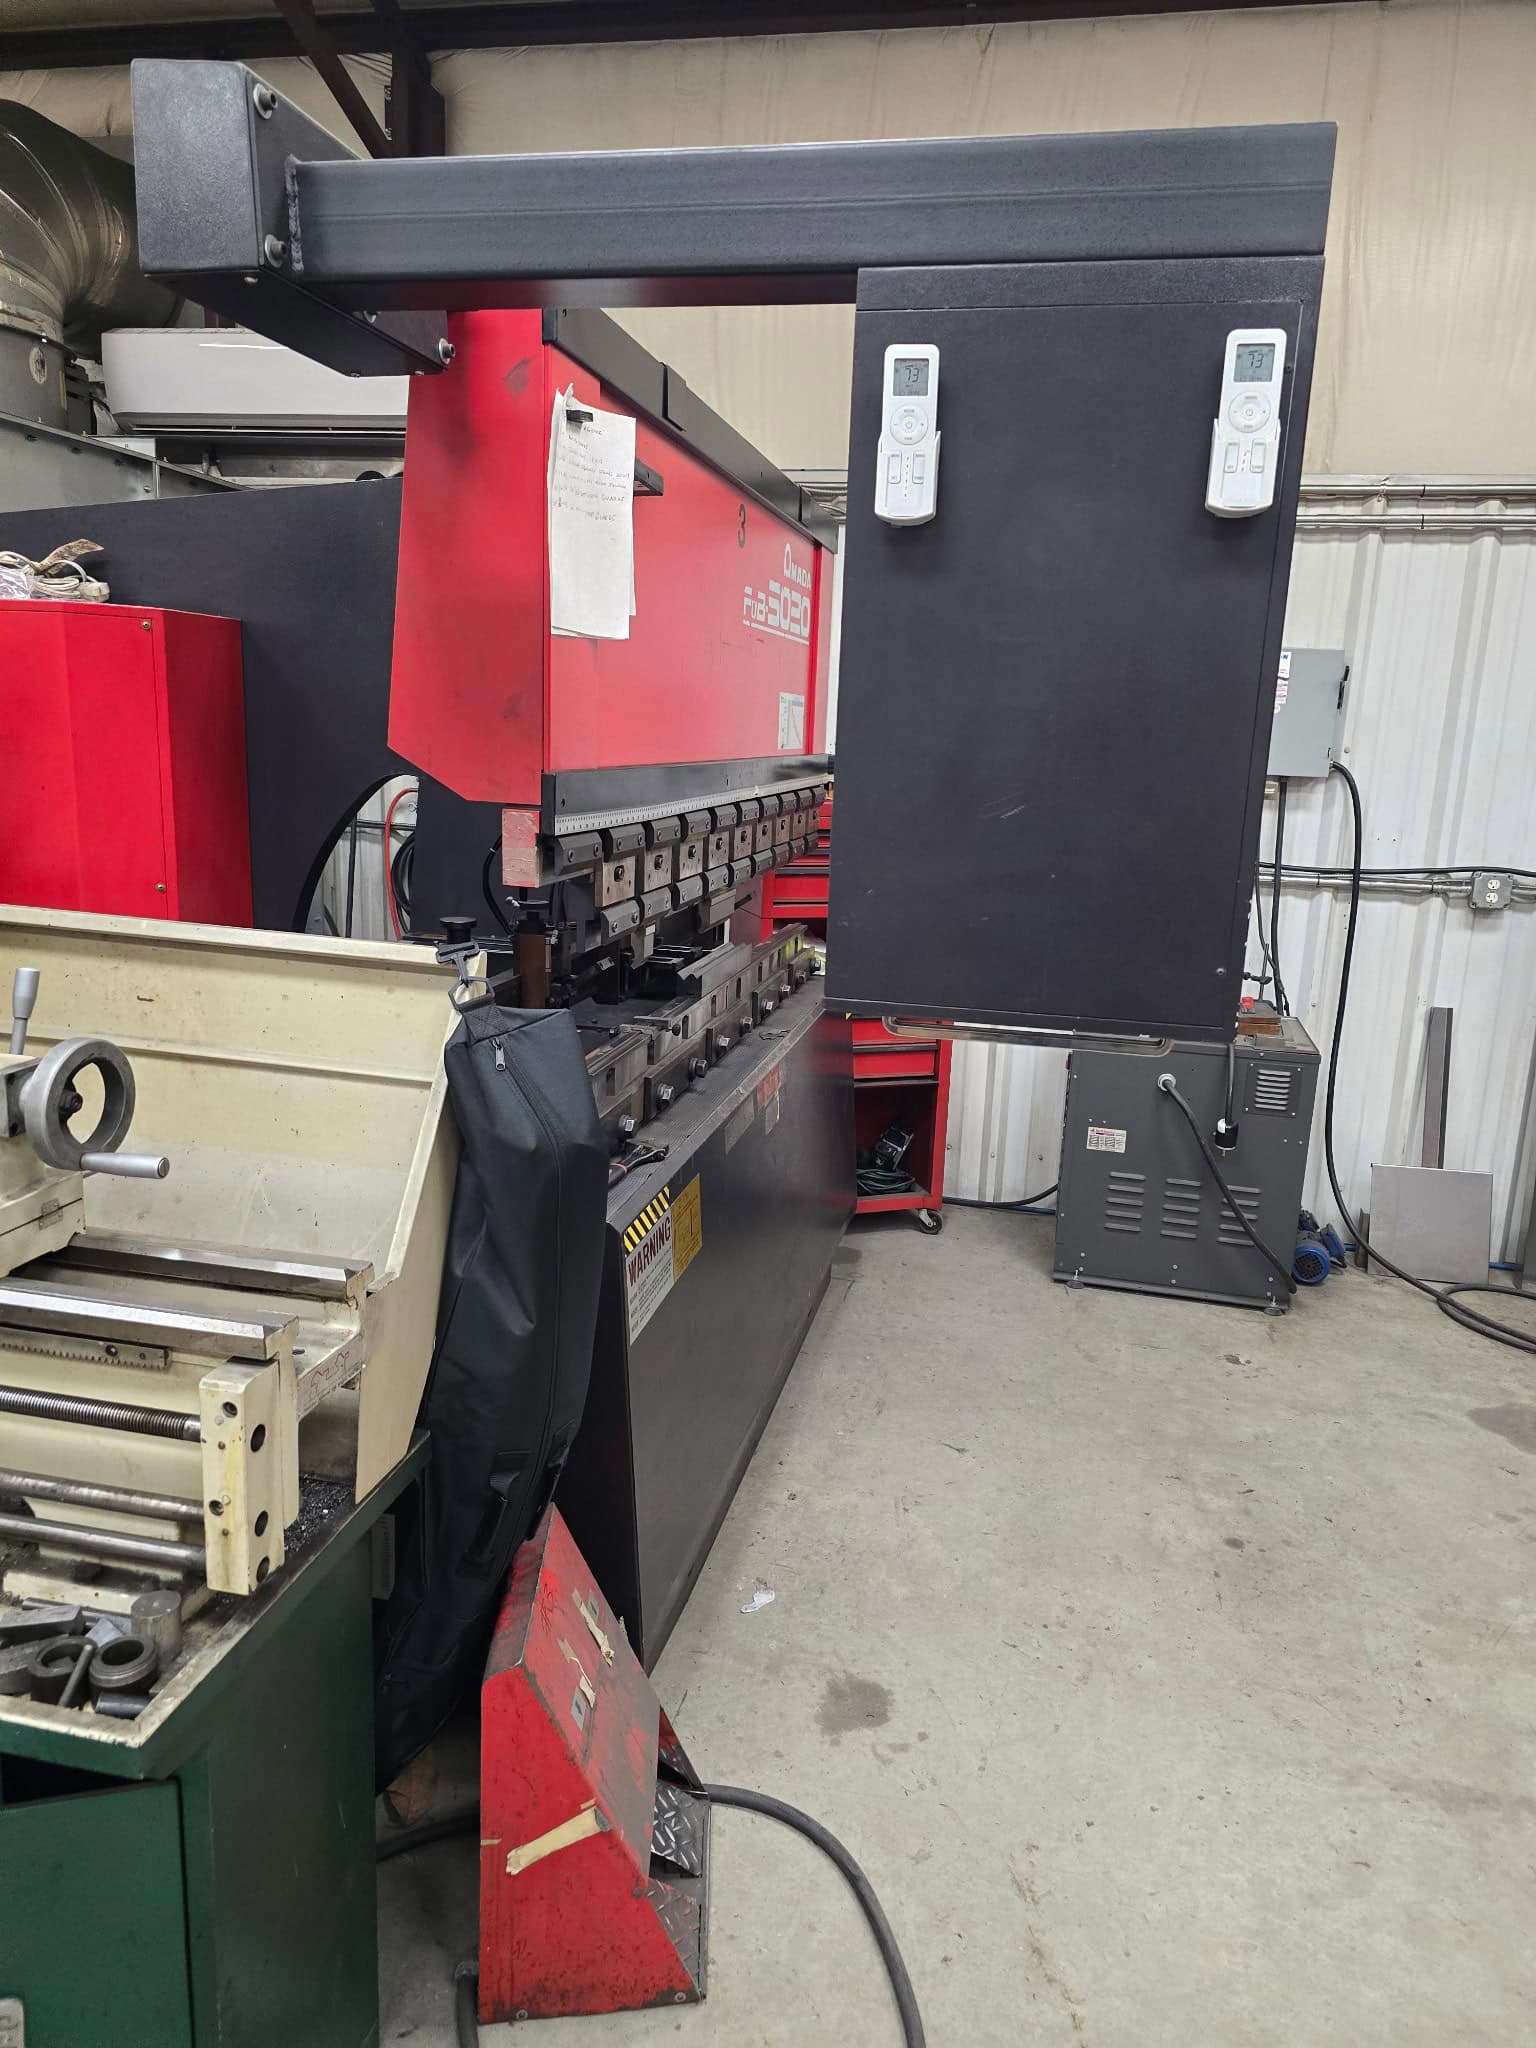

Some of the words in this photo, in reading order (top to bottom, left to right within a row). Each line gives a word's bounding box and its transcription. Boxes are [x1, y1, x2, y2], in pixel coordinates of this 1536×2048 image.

[905, 365, 920, 382] 73
[1248, 350, 1264, 368] 73
[737, 503, 746, 549] 3
[784, 543, 811, 590] AMADA
[628, 1217, 671, 1287] WARNING
